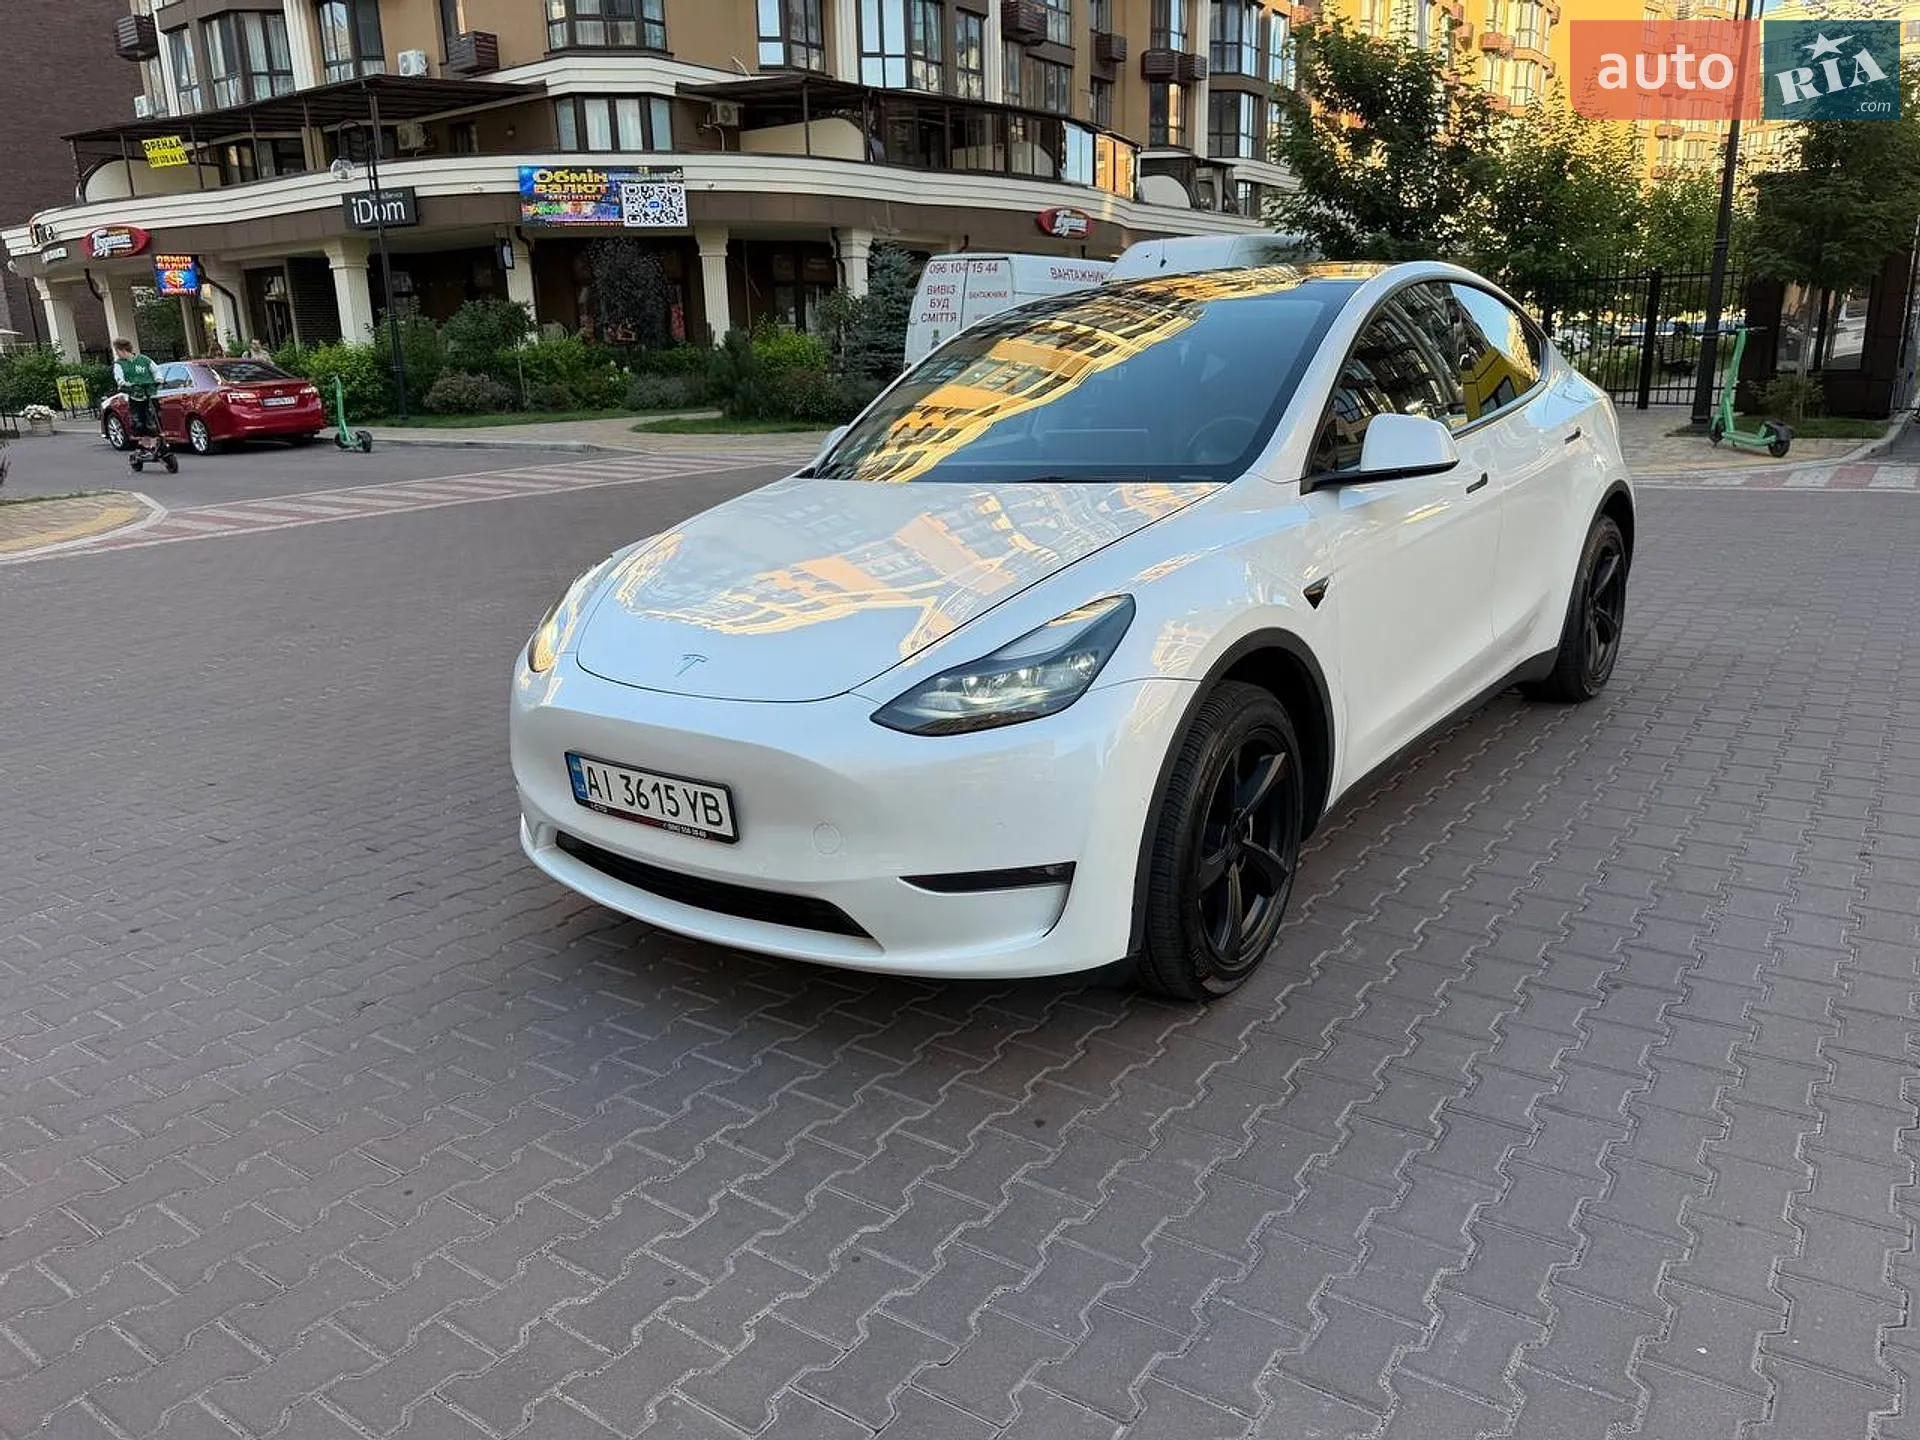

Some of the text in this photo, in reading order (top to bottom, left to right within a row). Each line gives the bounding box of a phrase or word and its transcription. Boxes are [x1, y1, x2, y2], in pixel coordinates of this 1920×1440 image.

[144, 138, 182, 151] ОРЕНДА
[351, 197, 405, 225] iDom
[928, 262, 948, 274] 096
[985, 262, 999, 274] 44
[927, 285, 956, 295] ВИВІЗ
[929, 298, 949, 309] БУД
[921, 311, 957, 323] СМІТТЯ
[586, 766, 723, 827] AI 3615 YB
